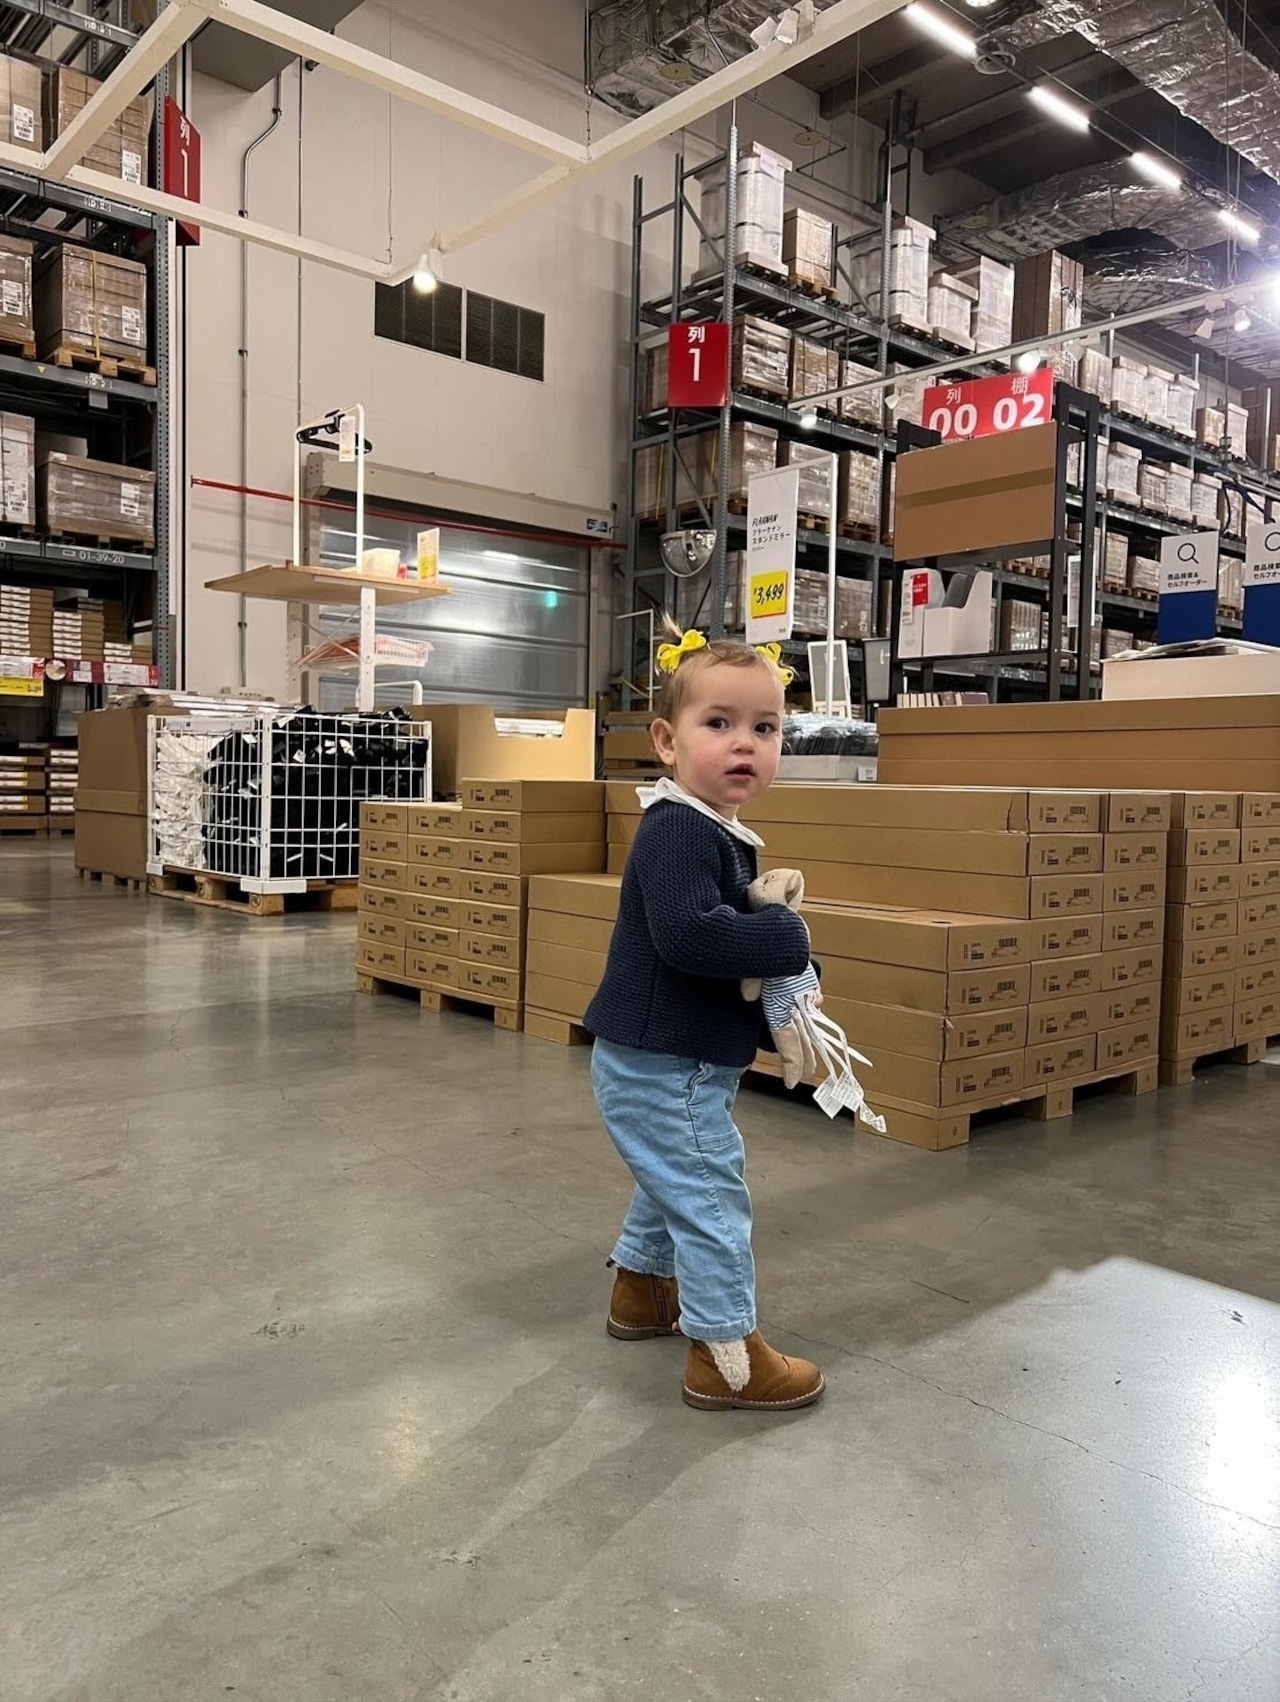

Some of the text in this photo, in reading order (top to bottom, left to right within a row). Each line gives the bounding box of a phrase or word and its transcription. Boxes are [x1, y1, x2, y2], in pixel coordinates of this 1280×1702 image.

[180, 115, 190, 146] 列
[181, 148, 188, 198] 1
[687, 325, 706, 344] 列
[688, 347, 700, 382] 1
[946, 376, 1029, 406] 列 棚
[929, 393, 1045, 438] 00 02
[79, 550, 125, 564] 01-39-20
[754, 583, 784, 605] ¥3,499
